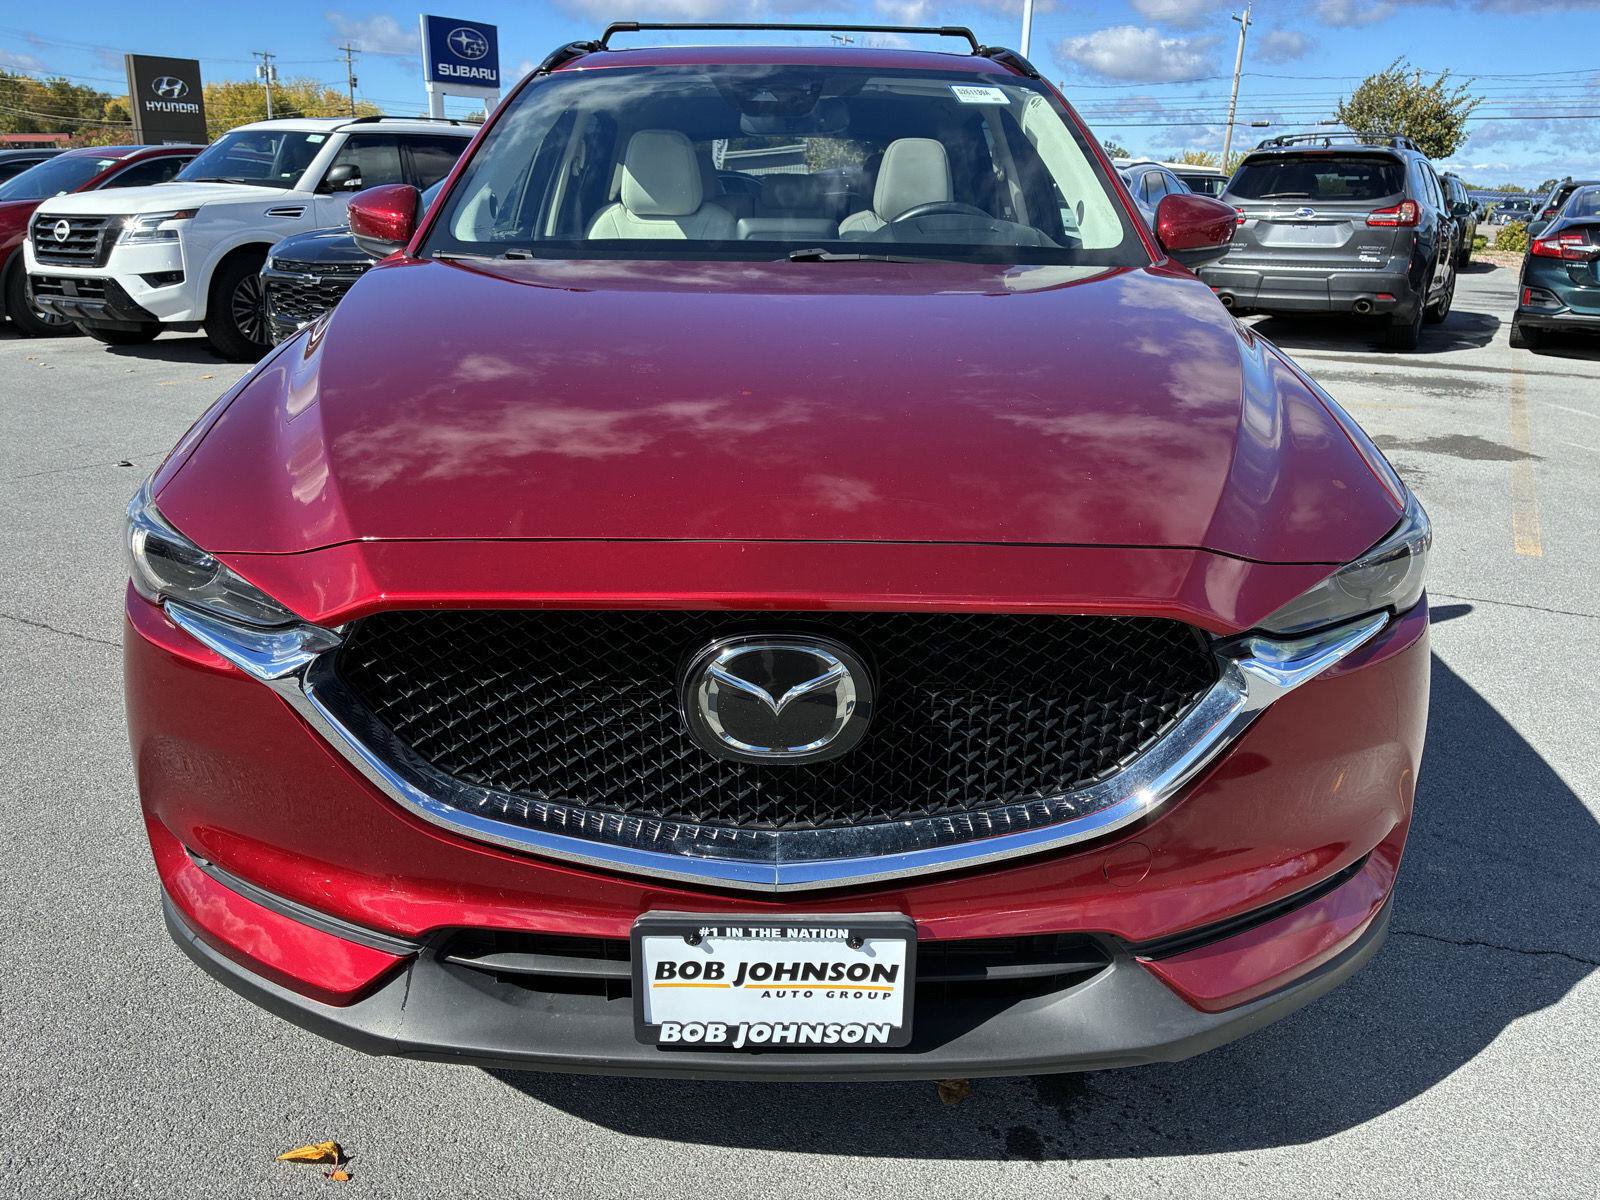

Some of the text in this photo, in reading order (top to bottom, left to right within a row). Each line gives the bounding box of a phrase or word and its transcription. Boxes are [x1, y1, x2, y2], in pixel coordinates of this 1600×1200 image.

[438, 63, 497, 80] SUBARU
[145, 101, 199, 113] HYUNDAI
[699, 927, 849, 939] #1 IN THE NATION
[655, 961, 899, 987] BOB JOHNSON
[761, 990, 892, 1000] AUTO GROUP
[659, 1022, 890, 1048] BOB JOHNSON
